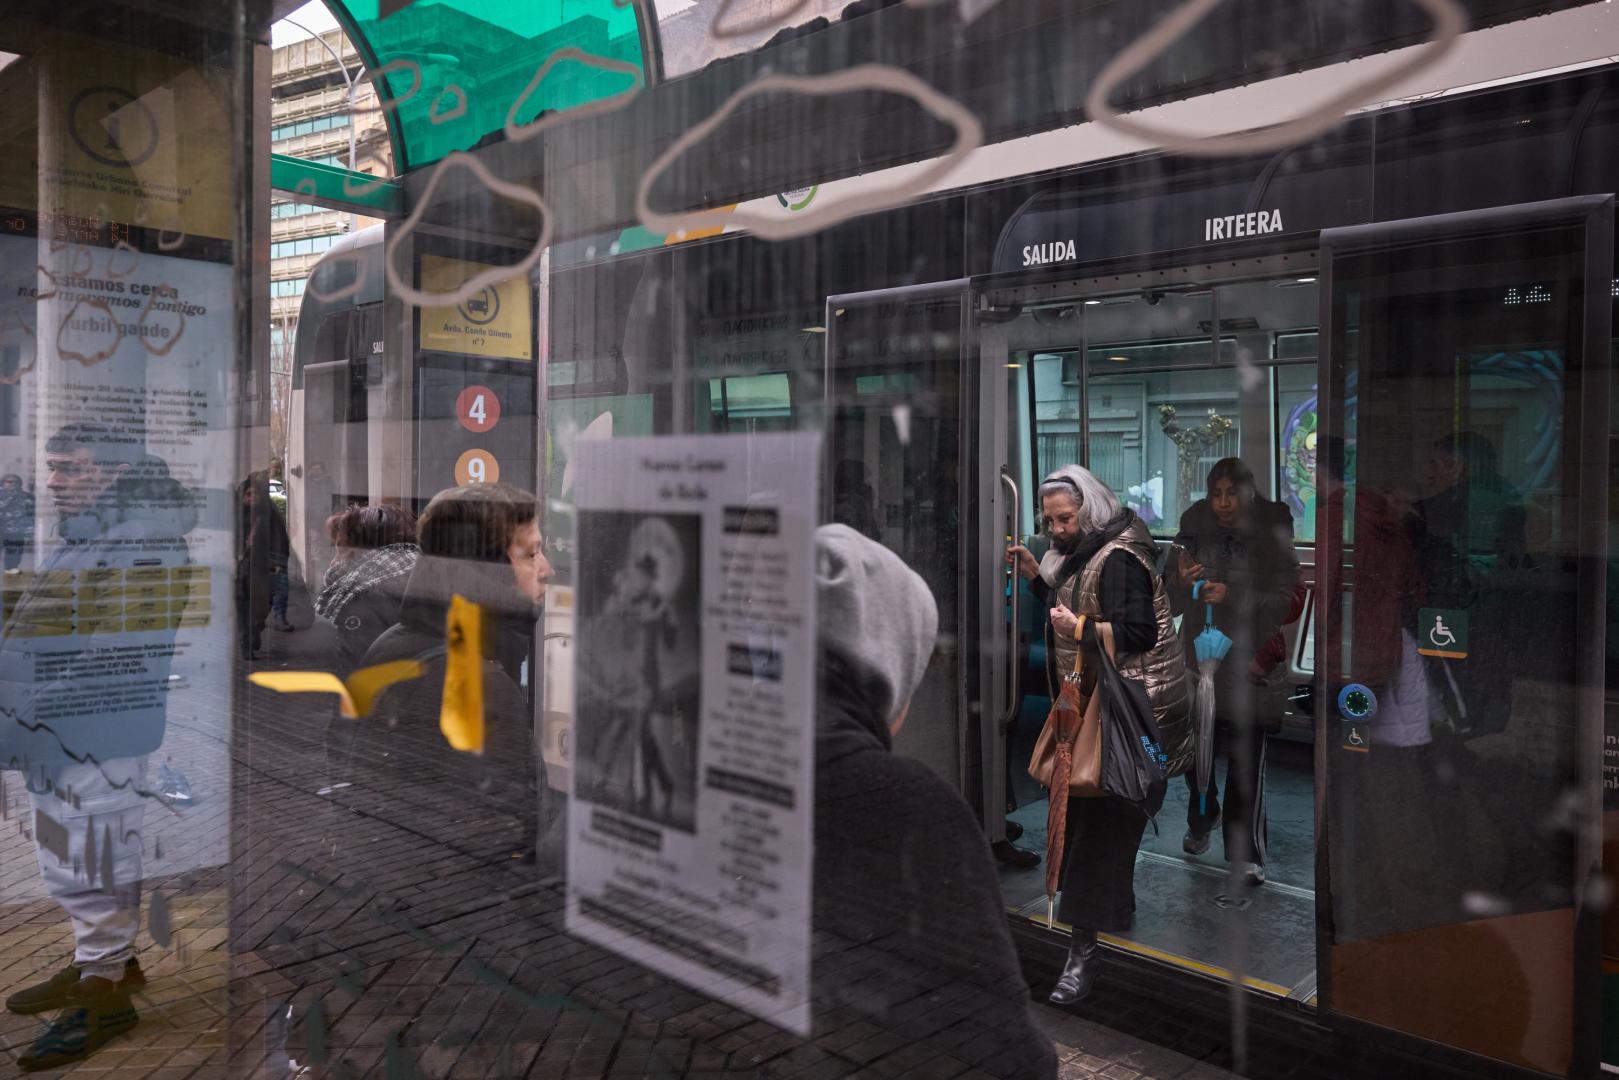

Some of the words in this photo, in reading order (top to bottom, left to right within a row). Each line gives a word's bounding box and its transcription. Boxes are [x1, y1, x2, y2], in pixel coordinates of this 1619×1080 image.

[1205, 208, 1283, 241] IRTEERA
[1023, 240, 1076, 266] SALIDA
[130, 282, 178, 300] cerca
[150, 300, 208, 317] contigo
[468, 394, 486, 425] 4
[468, 458, 486, 484] 9
